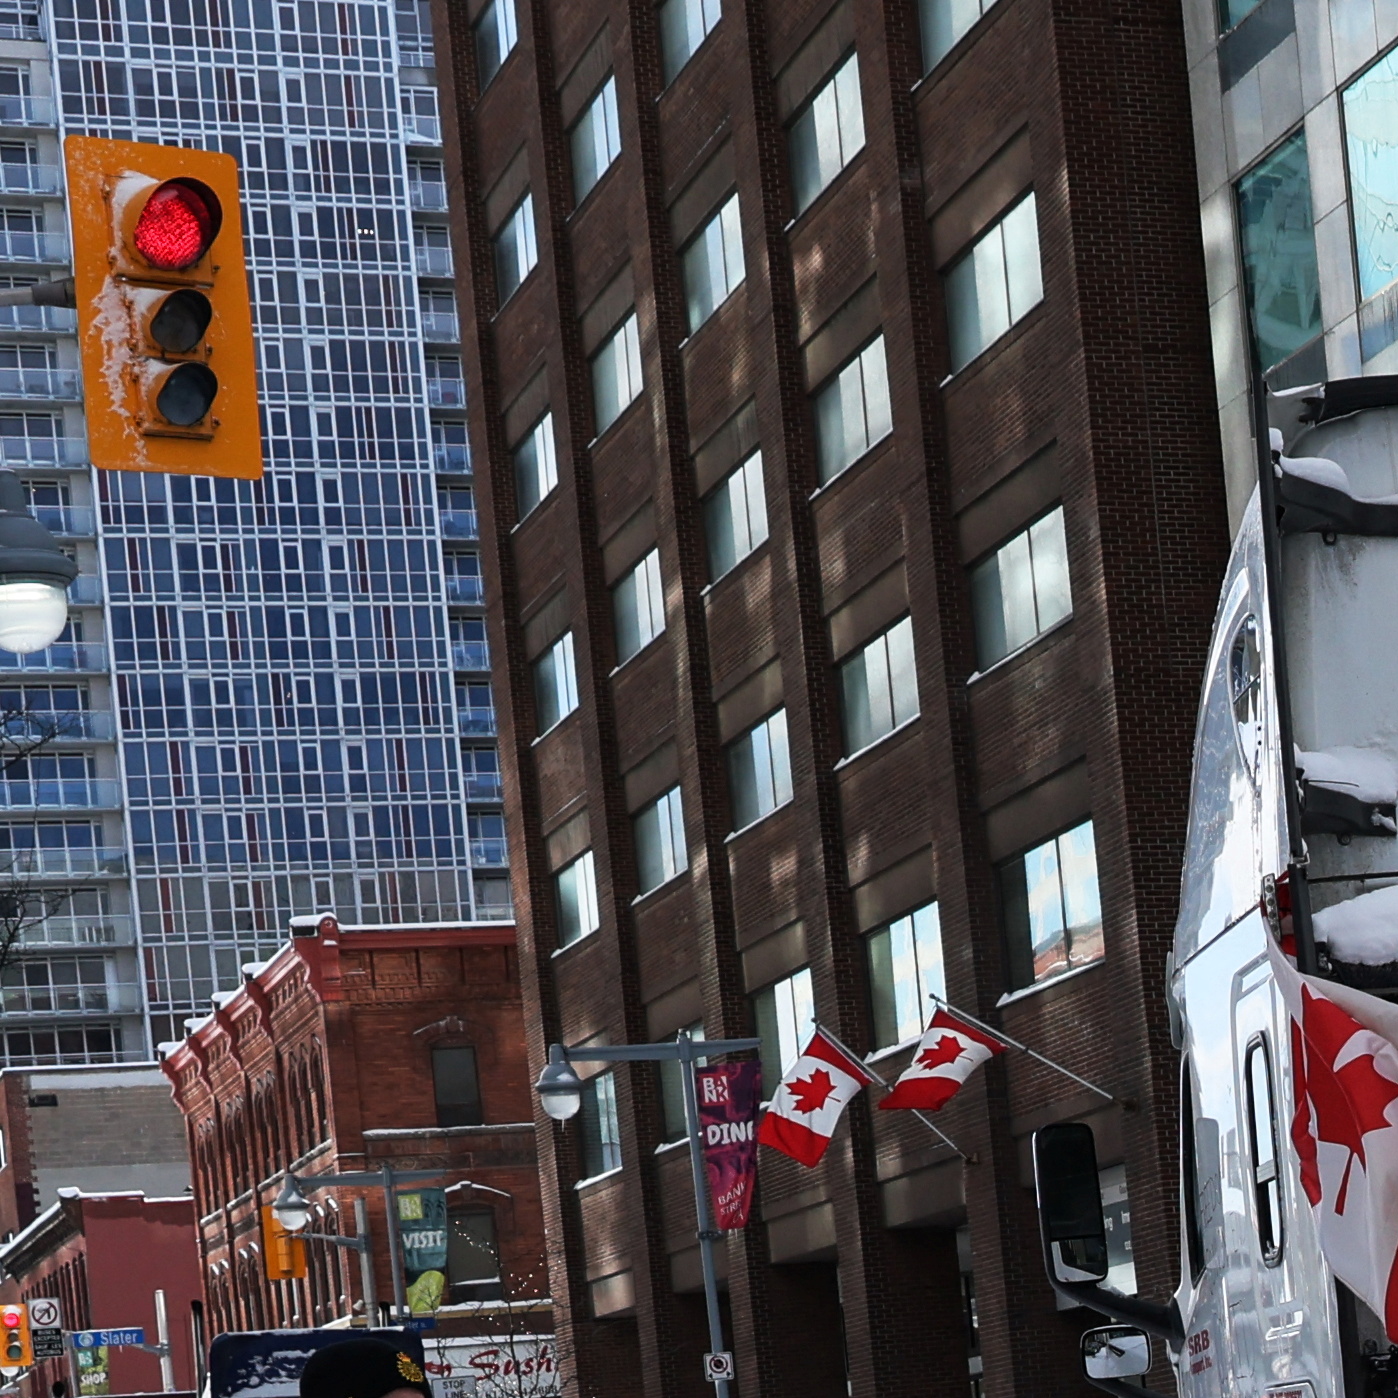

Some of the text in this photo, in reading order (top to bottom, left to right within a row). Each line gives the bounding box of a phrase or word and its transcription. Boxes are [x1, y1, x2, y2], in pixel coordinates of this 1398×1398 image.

[402, 1230, 444, 1249] VISIT
[99, 1331, 138, 1345] Slater
[1187, 1329, 1211, 1356] SRB
[81, 1371, 107, 1386] SHOP
[442, 1380, 466, 1390] STOP
